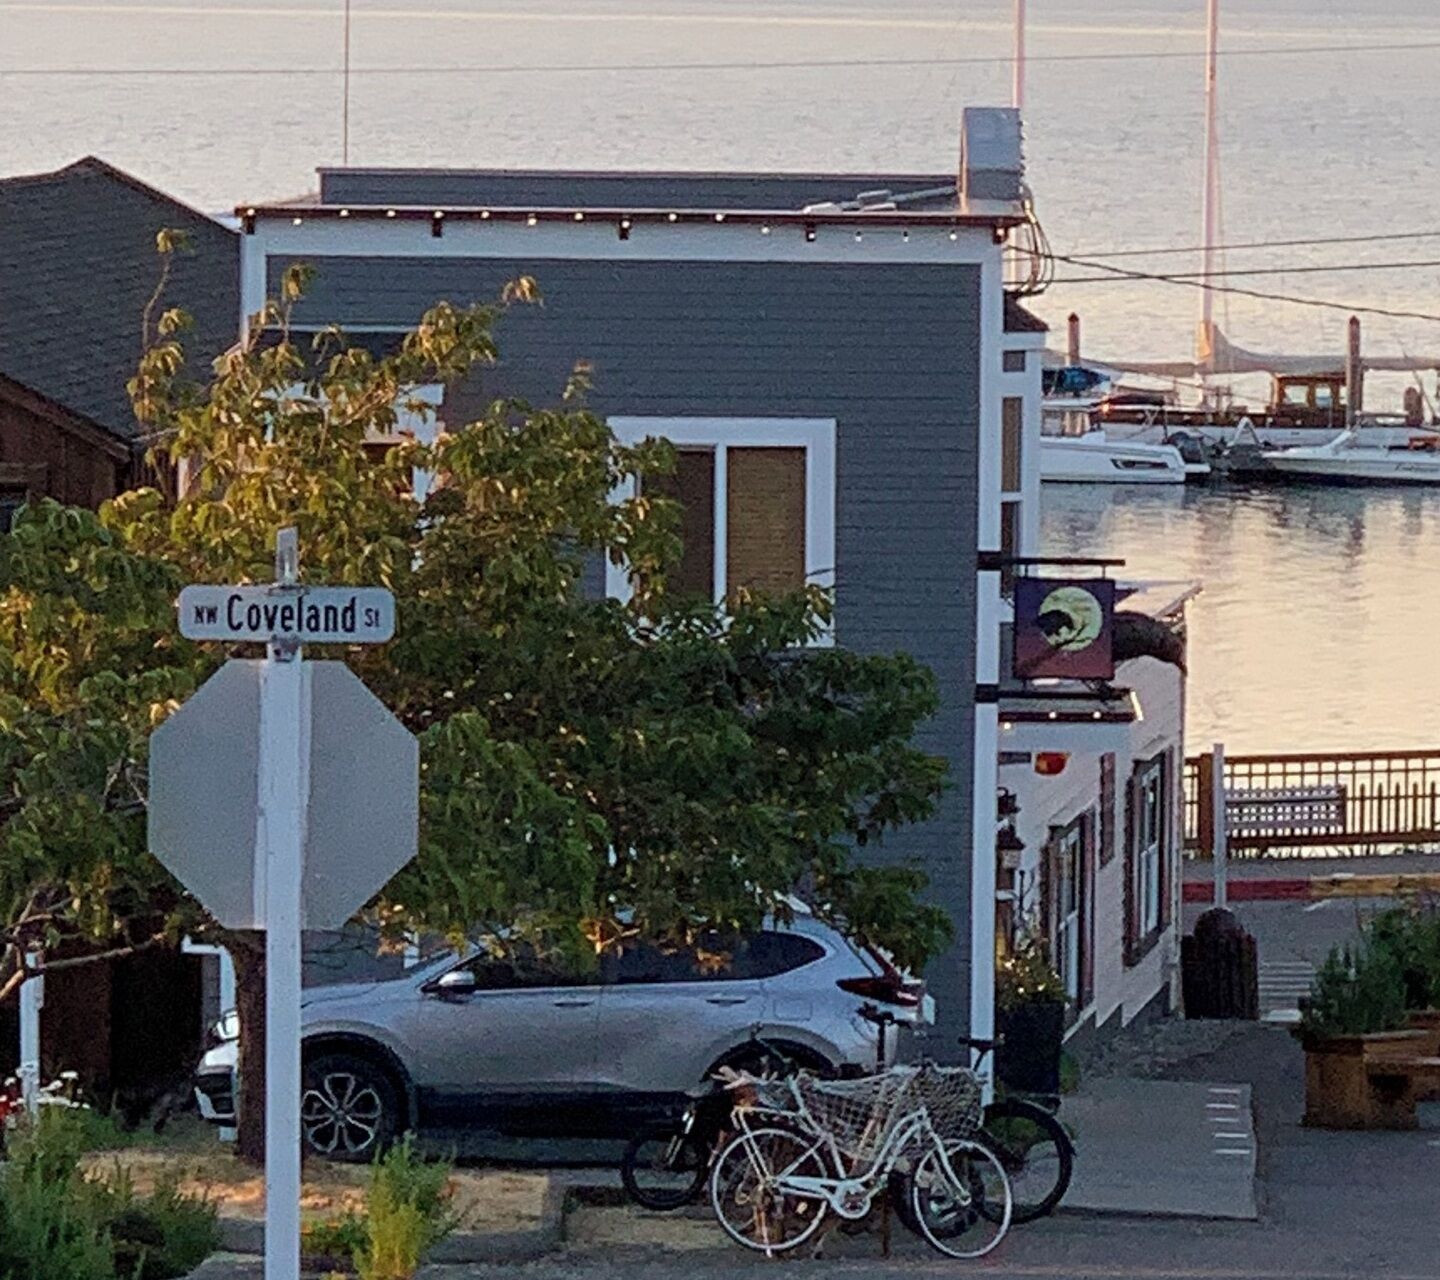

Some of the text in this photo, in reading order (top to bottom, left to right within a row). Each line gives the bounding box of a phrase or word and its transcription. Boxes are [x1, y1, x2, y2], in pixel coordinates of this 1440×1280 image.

[194, 594, 381, 632] NW Coveland St
